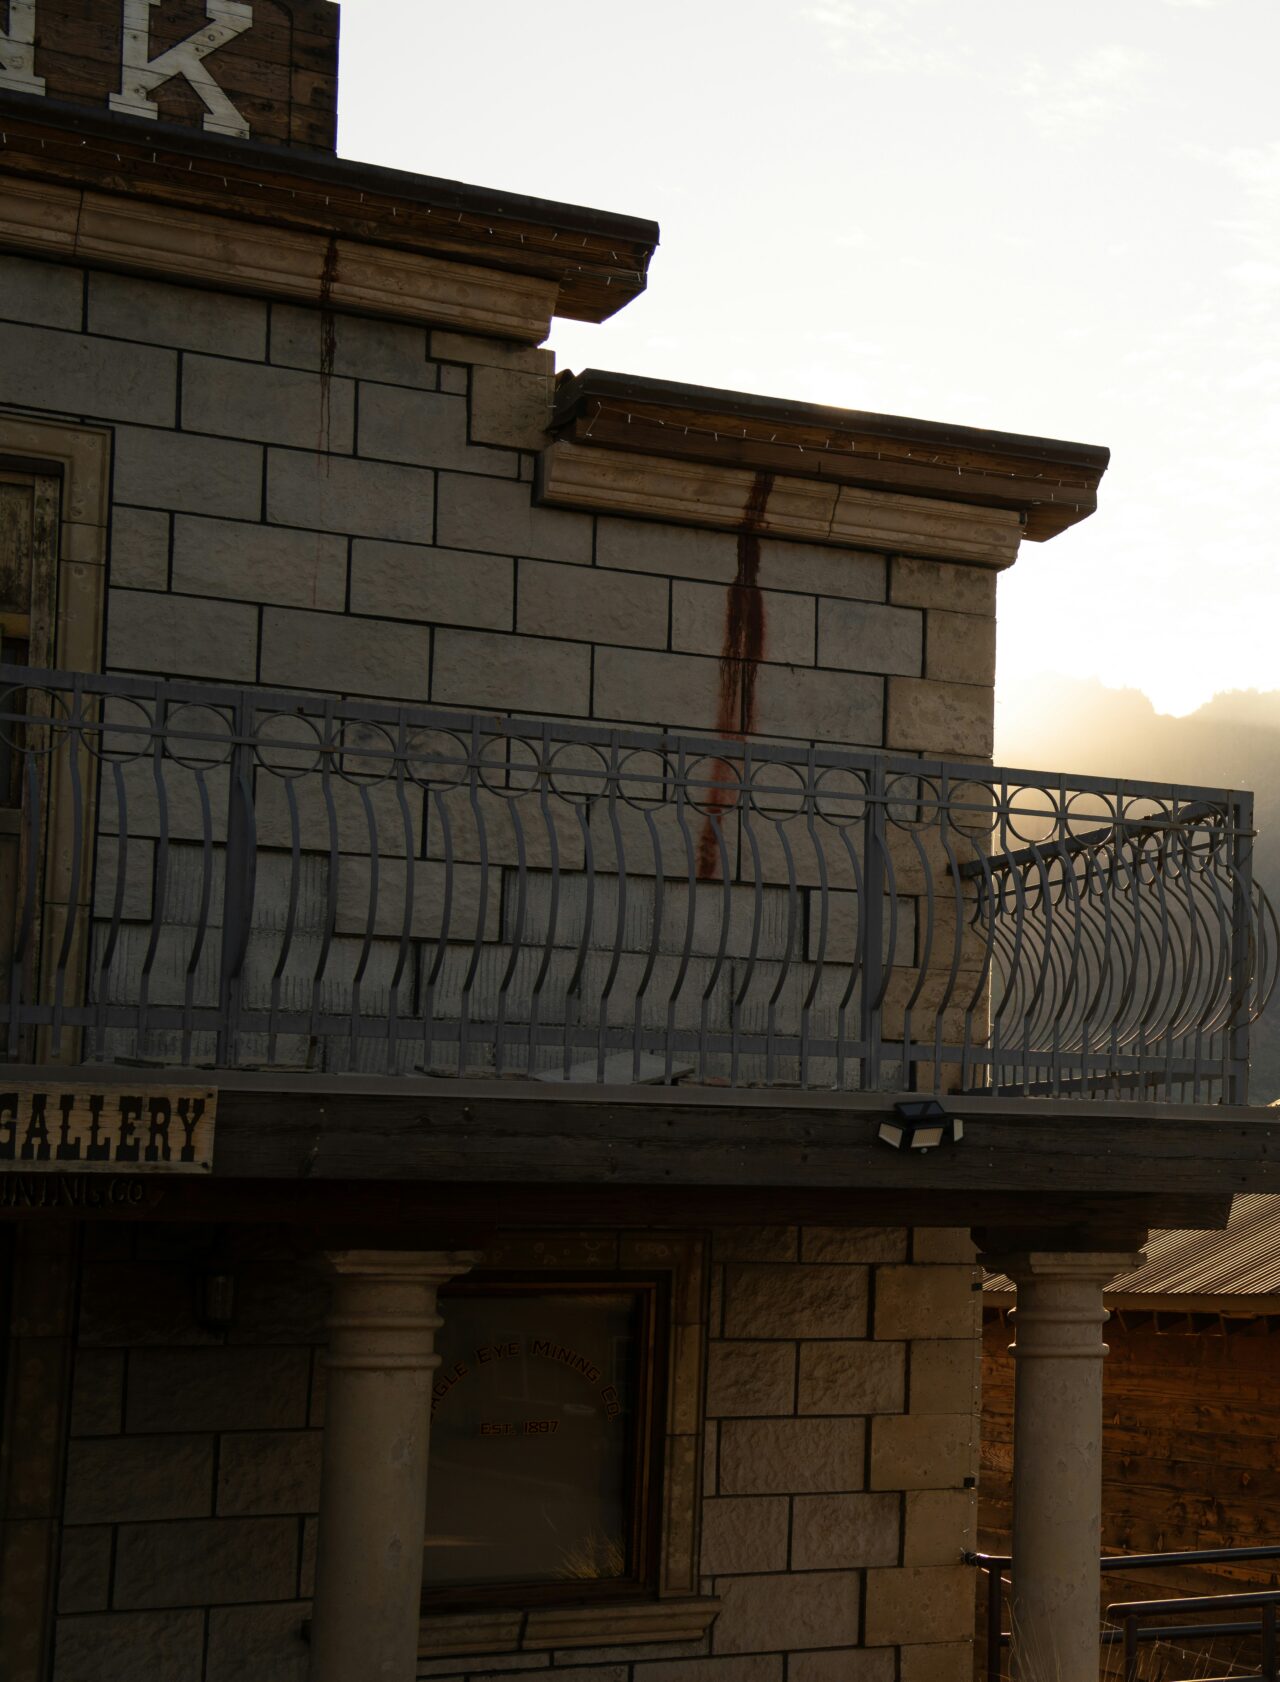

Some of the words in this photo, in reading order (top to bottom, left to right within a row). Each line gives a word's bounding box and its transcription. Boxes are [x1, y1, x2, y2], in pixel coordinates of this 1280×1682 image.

[0, 1093, 205, 1162] GALLERY
[430, 1363, 469, 1427] AGLE
[475, 1342, 520, 1365] EYE
[532, 1340, 602, 1383] MINING
